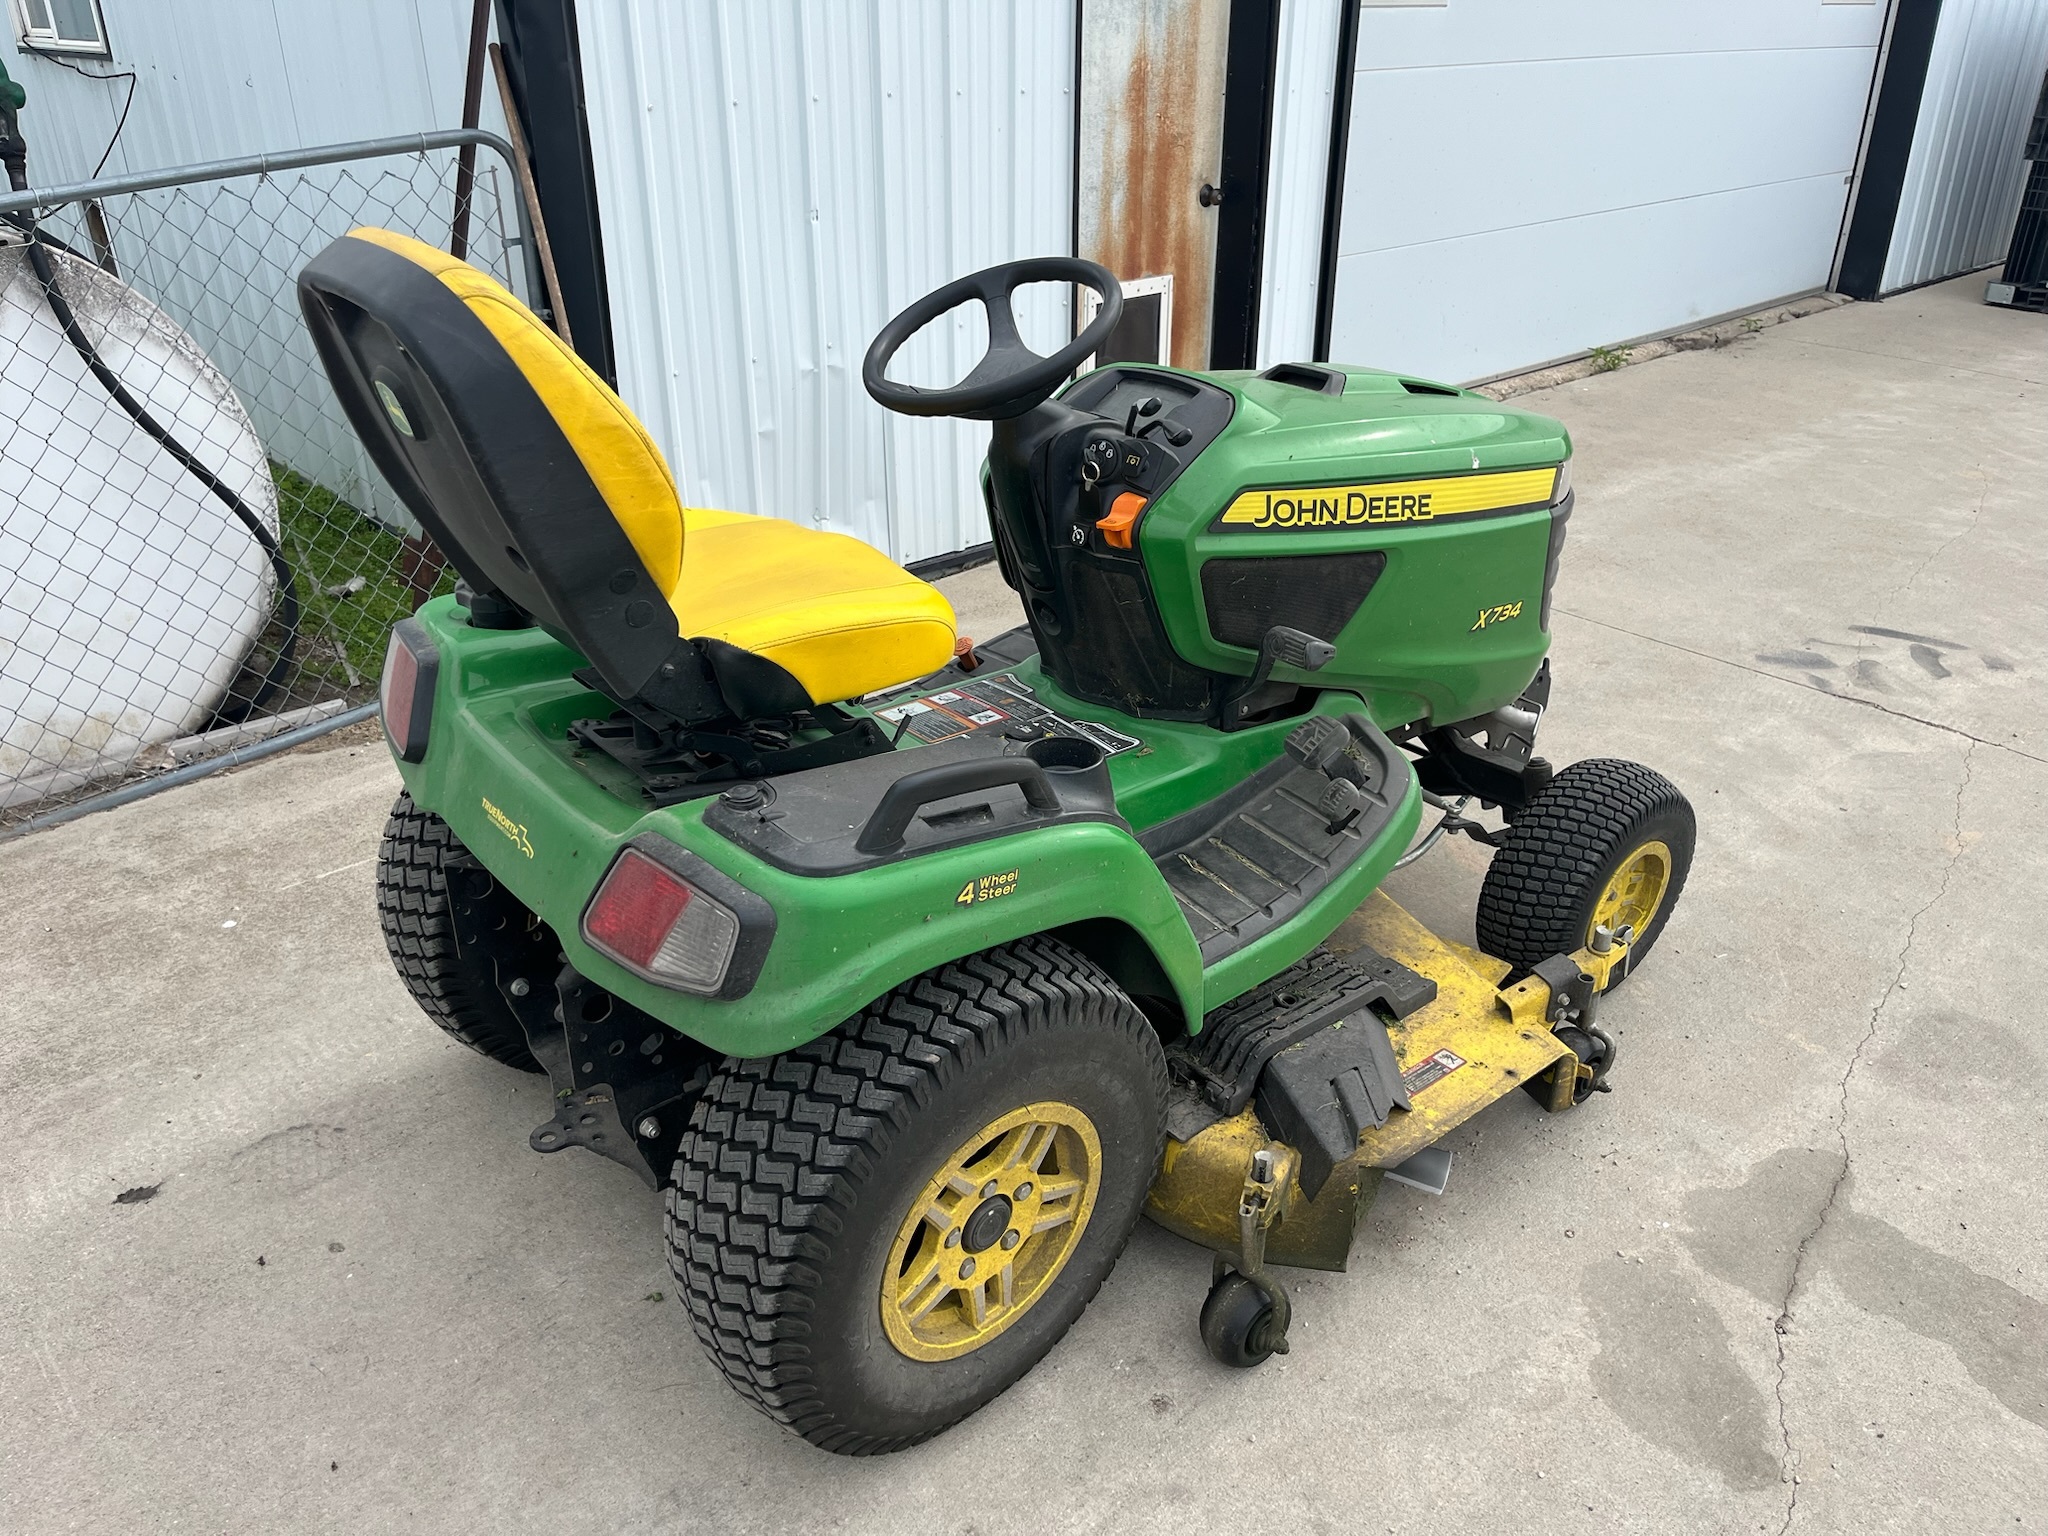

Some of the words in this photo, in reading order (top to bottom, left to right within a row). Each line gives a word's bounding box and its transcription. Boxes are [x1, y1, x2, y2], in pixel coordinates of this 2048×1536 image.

[1254, 494, 1339, 524] JOHN
[1346, 493, 1433, 521] DEERE
[1470, 601, 1523, 631] X734
[957, 882, 975, 904] 4
[979, 868, 1019, 889] Wheel
[978, 883, 1017, 902] Steer
